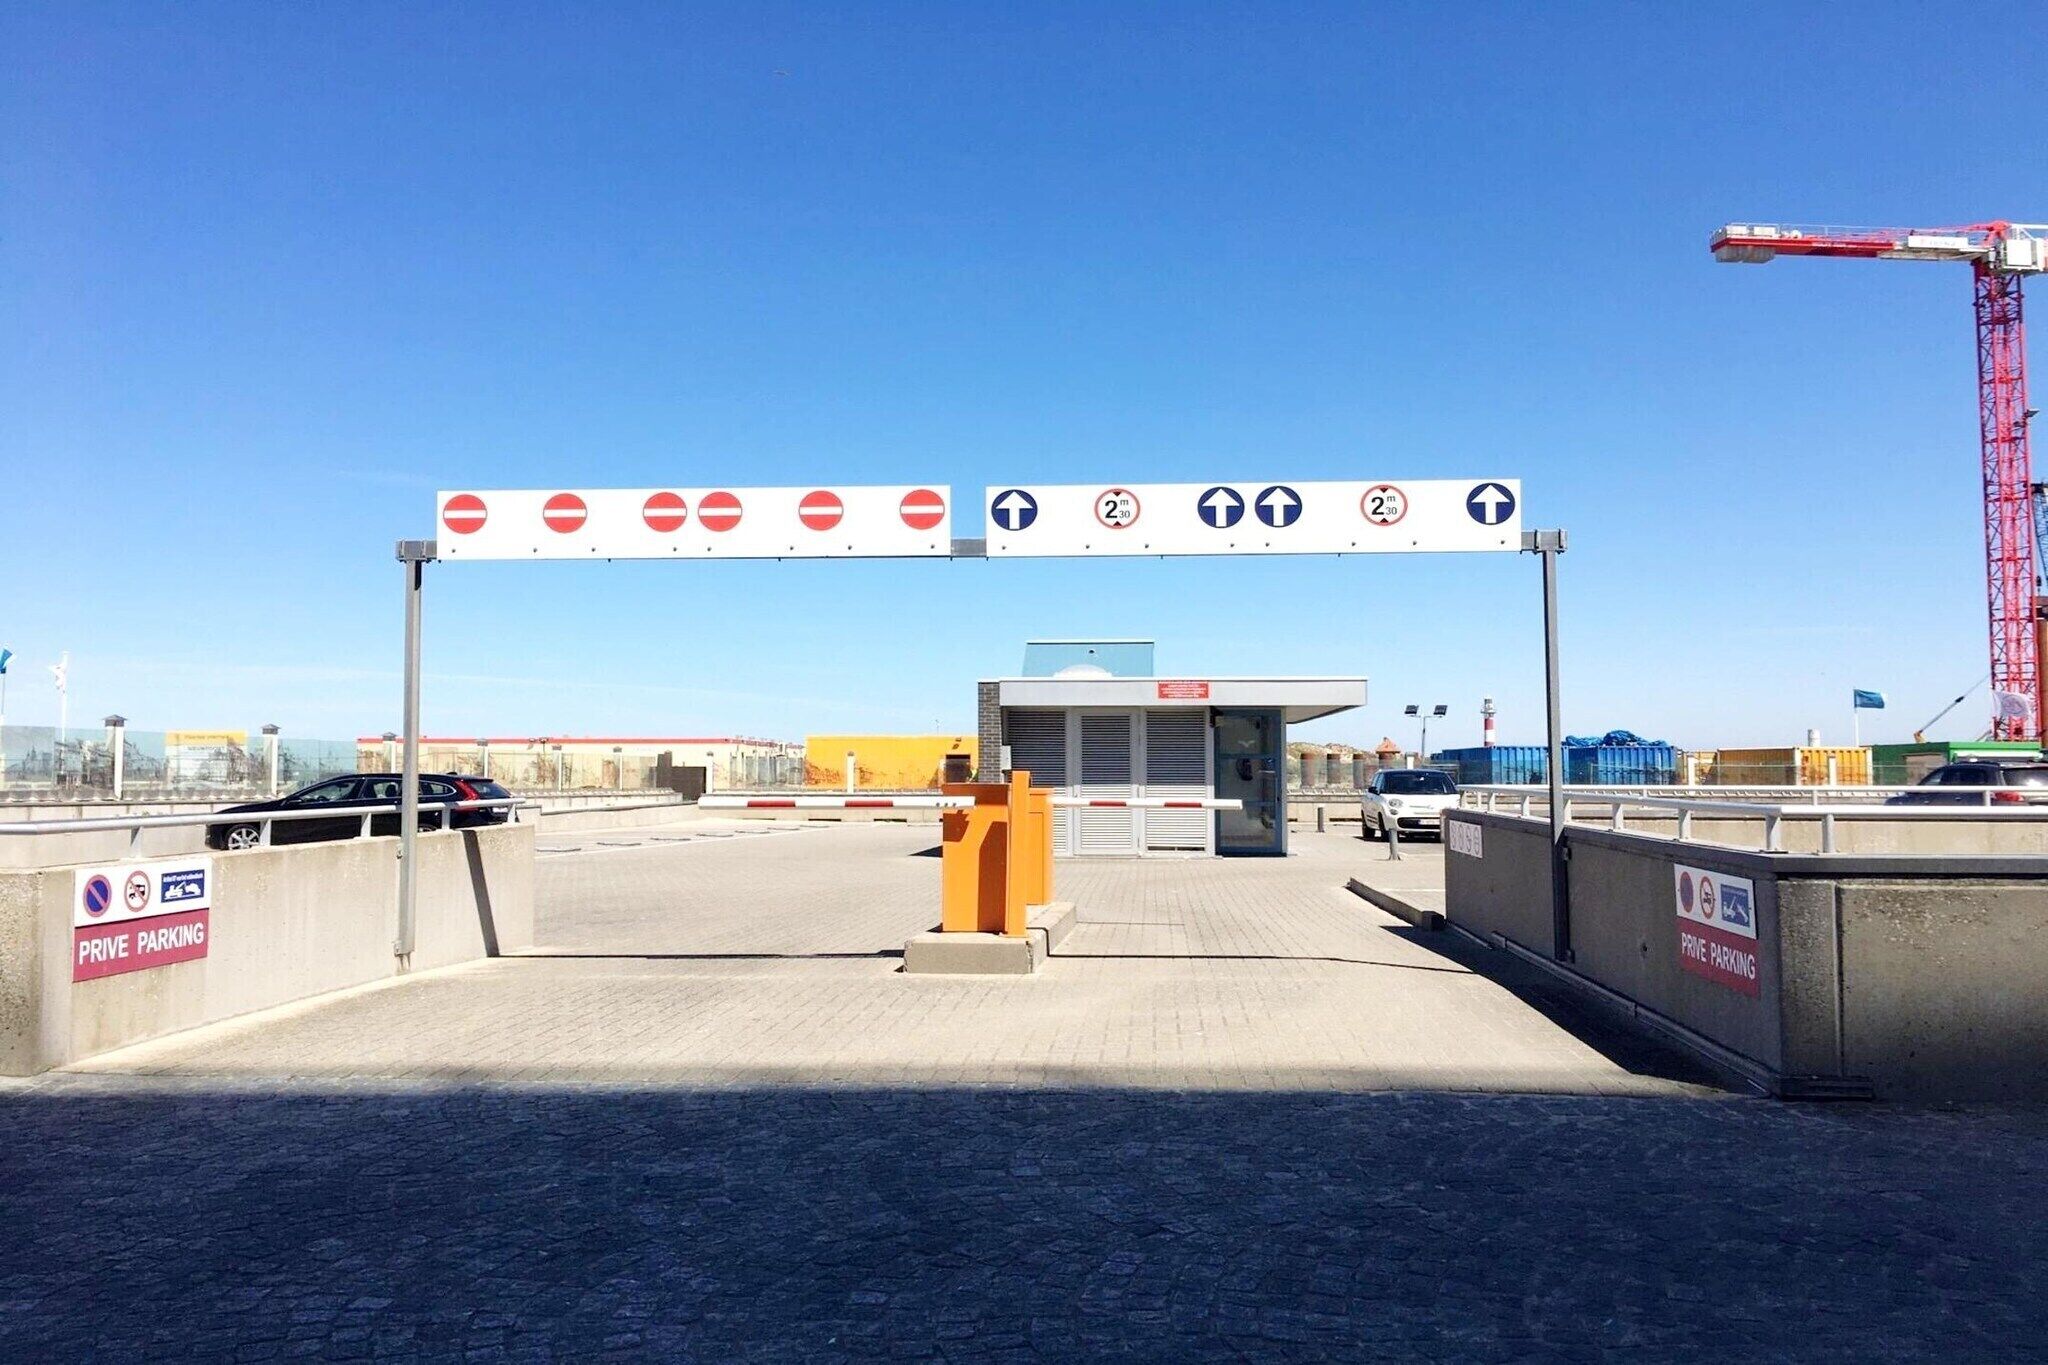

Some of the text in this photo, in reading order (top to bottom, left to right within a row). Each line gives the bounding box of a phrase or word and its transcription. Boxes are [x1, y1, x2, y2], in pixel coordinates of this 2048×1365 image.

[1104, 500, 1118, 518] 2
[1118, 510, 1131, 518] 30
[1371, 496, 1384, 515] 2
[1385, 506, 1398, 515] 30
[79, 922, 205, 965] PRIVE PARKING
[1681, 932, 1756, 980] PRIVE PARKING
